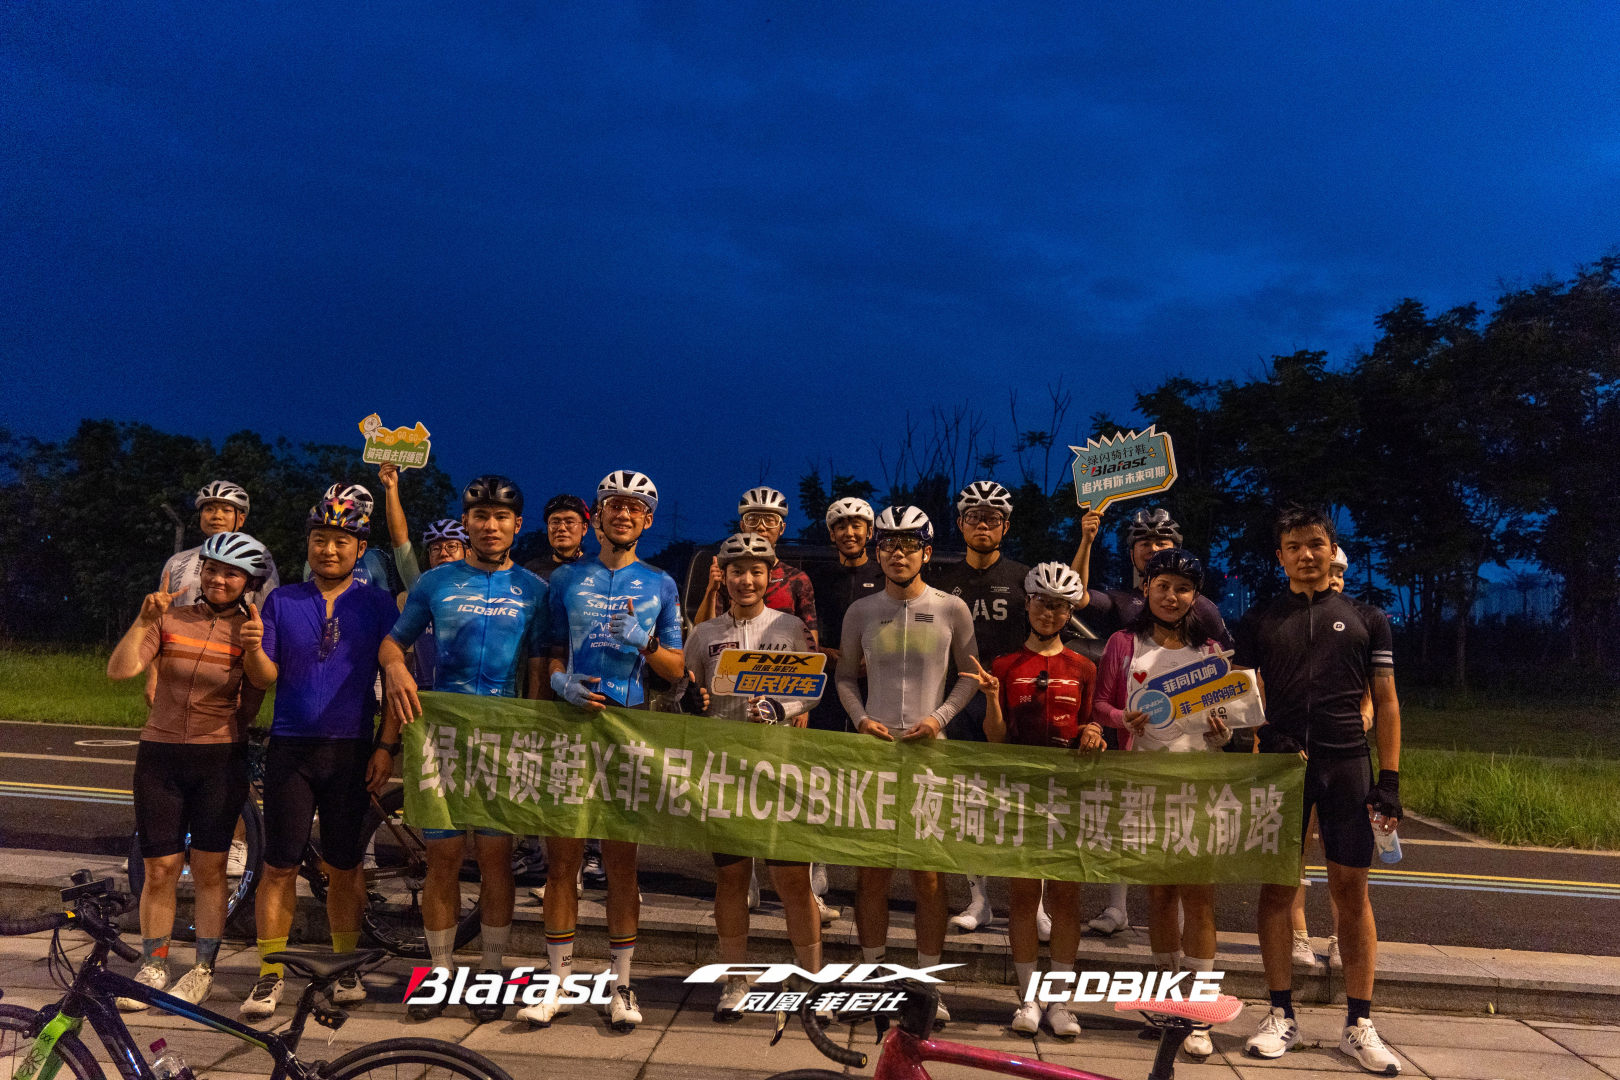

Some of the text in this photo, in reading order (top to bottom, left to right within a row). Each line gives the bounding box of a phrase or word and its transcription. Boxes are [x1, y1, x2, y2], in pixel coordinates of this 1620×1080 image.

[1087, 443, 1148, 466] 绿闪骑行鞋
[1090, 456, 1148, 477] Blafast
[1081, 465, 1166, 495] 追光有你 未来可期
[758, 643, 788, 651] MAAP
[738, 653, 815, 666] FNIX
[736, 674, 820, 695] 国民好车
[1161, 663, 1218, 694] 菲同凡响
[1178, 681, 1248, 715] 菲一般的骑士
[910, 768, 1285, 856] 夜骑打卡成都成渝路
